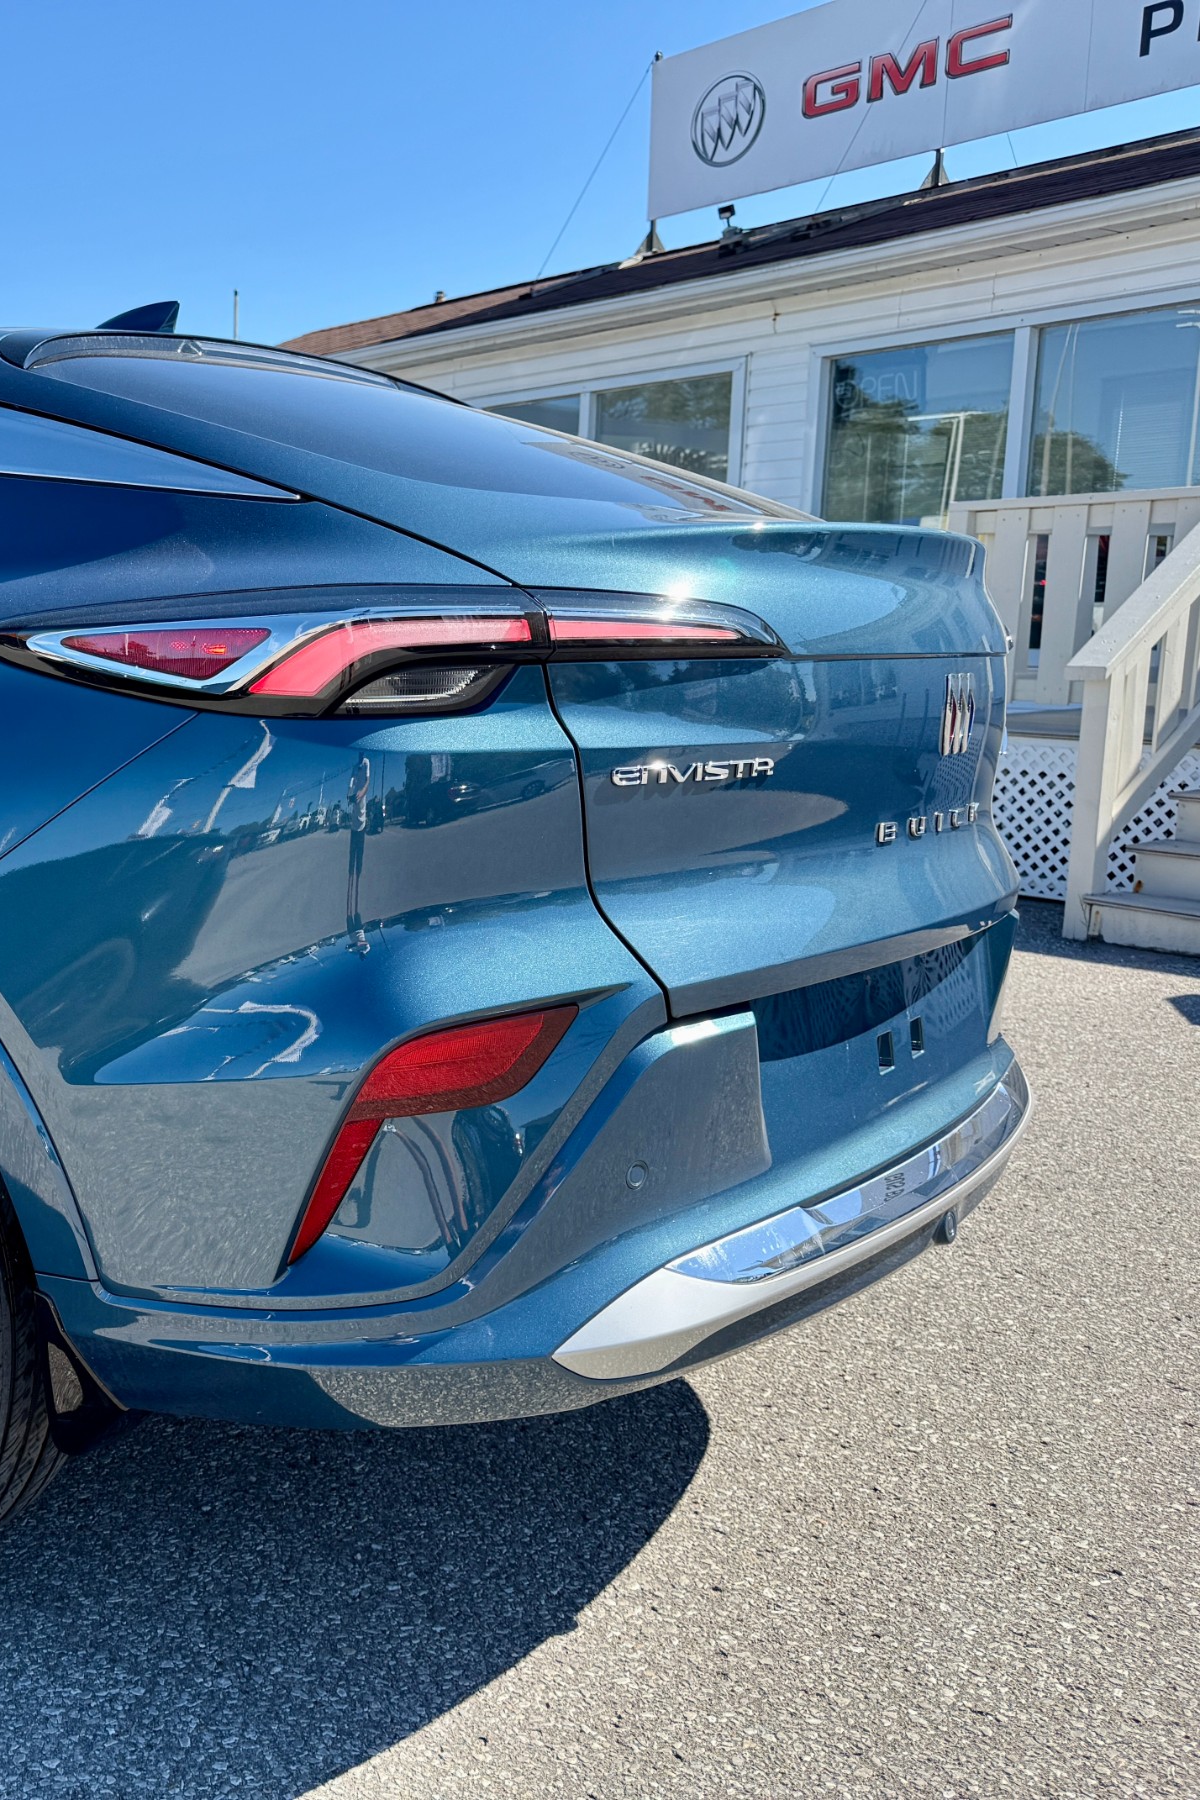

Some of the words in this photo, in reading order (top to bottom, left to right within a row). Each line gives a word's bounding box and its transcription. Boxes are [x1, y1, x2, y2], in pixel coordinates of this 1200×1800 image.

[1139, 0, 1200, 58] P
[802, 13, 1013, 119] GMC
[835, 370, 917, 408] OPEN
